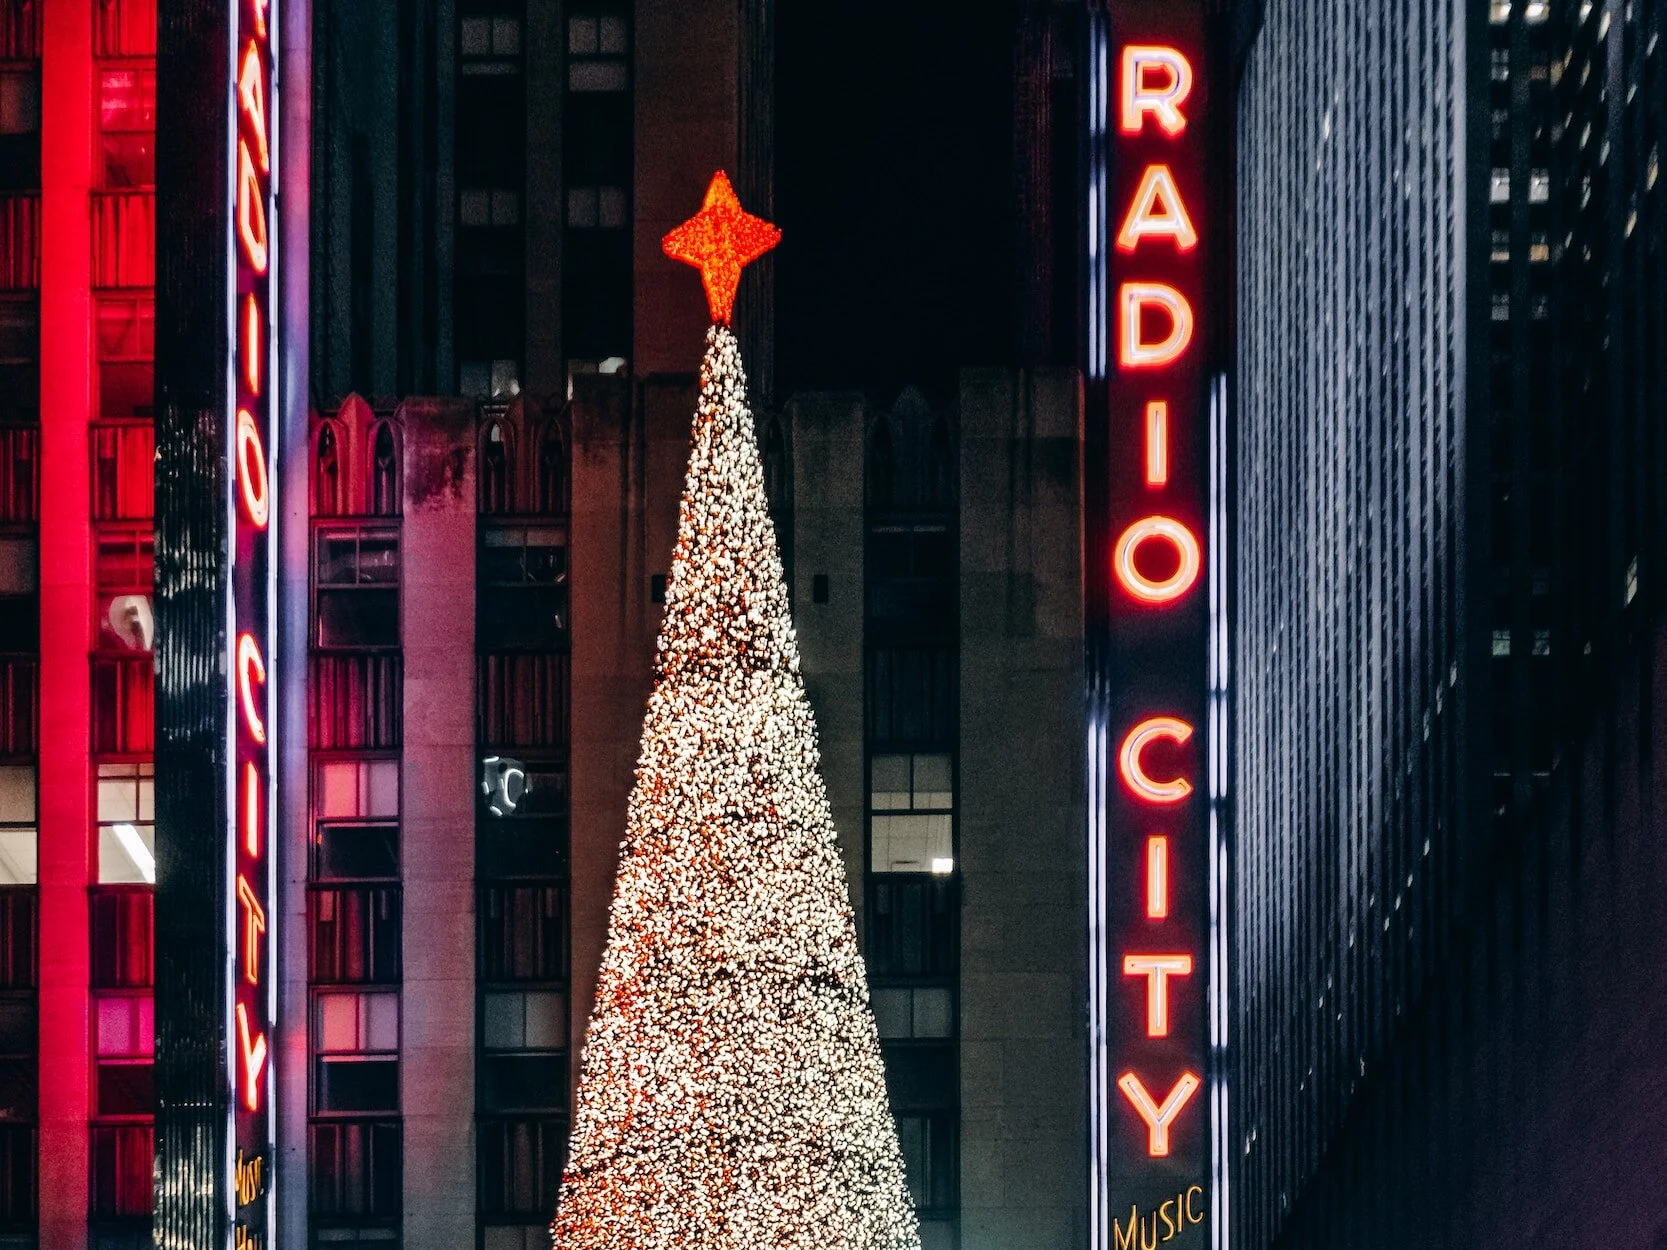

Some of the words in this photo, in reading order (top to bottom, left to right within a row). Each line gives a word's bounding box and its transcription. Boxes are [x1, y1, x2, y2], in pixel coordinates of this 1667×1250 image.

[237, 0, 271, 531] ADIO
[1114, 44, 1201, 603] RADIO
[236, 633, 268, 1113] CITY
[1117, 716, 1201, 1158] CITY
